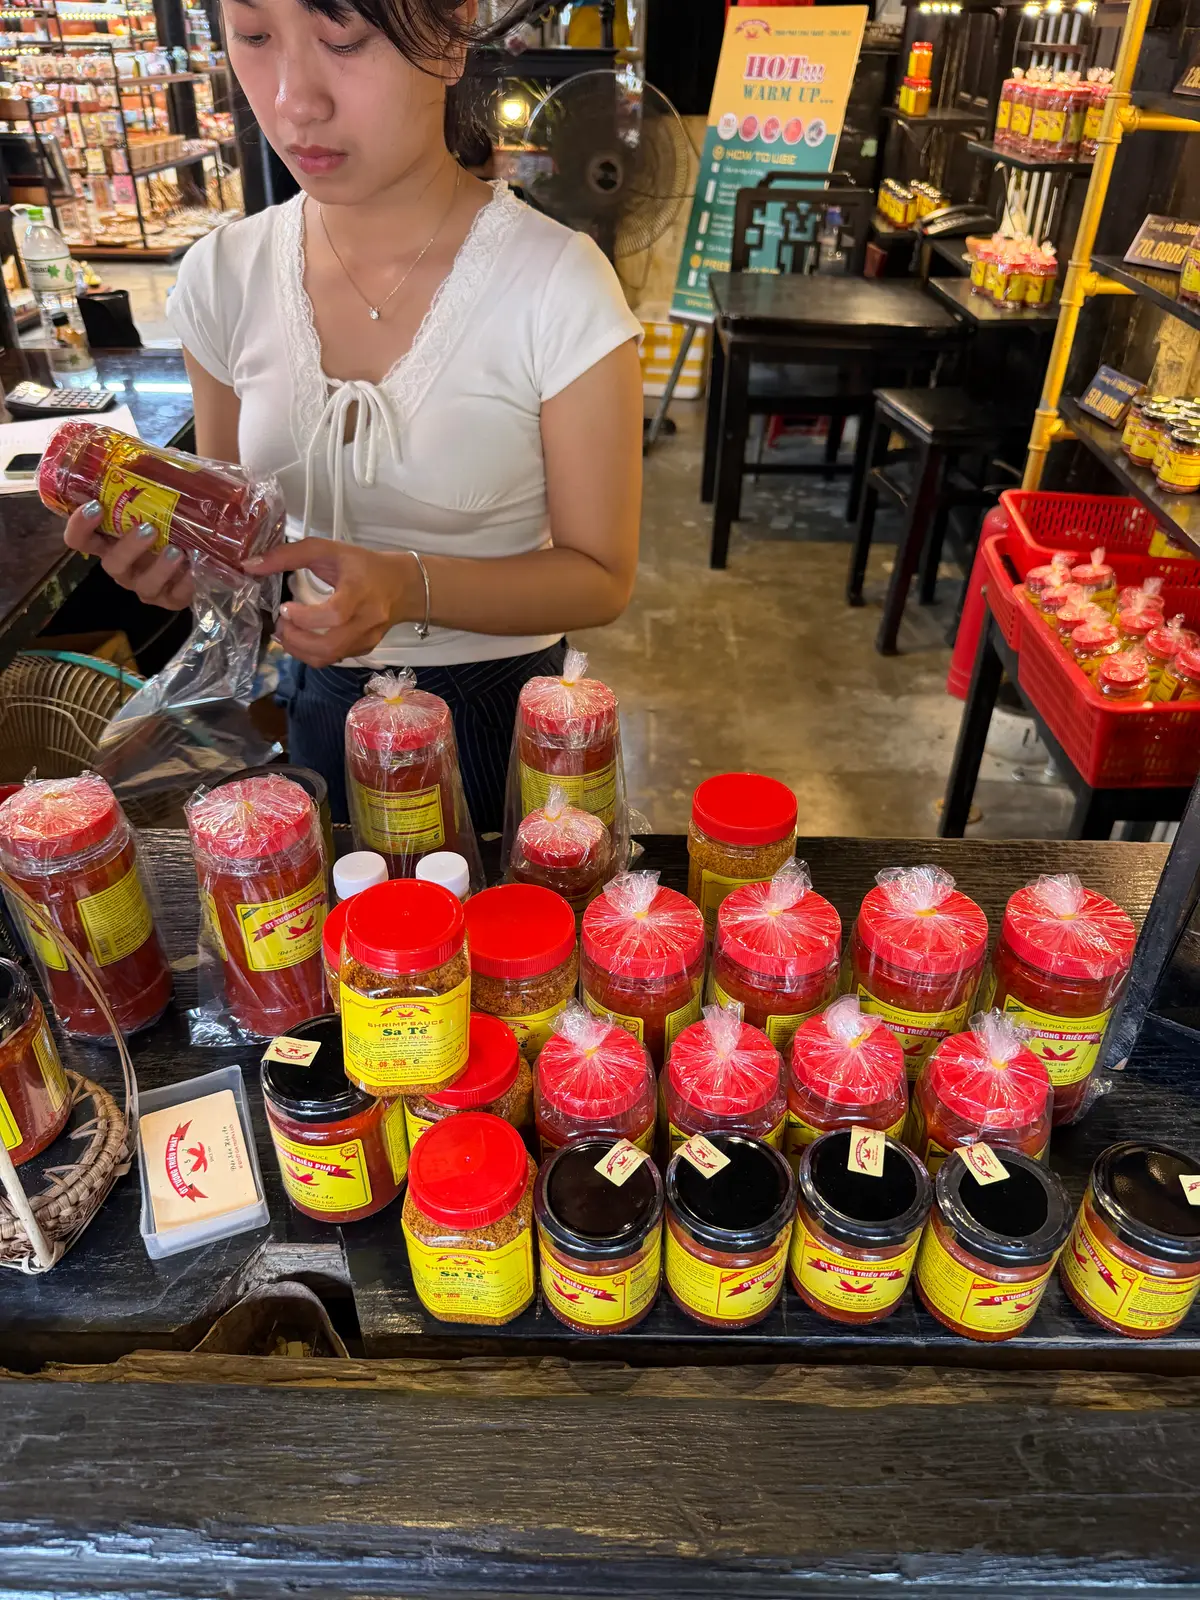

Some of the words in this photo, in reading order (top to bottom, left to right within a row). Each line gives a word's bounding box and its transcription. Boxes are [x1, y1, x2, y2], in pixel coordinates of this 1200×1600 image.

[745, 54, 824, 82] HOT!!!
[744, 84, 792, 101] WARM
[725, 150, 753, 161] HOW
[755, 152, 771, 162] TO
[368, 1020, 407, 1028] SHRIMP
[410, 1018, 444, 1026] SAUCE
[383, 1028, 402, 1036] Sa
